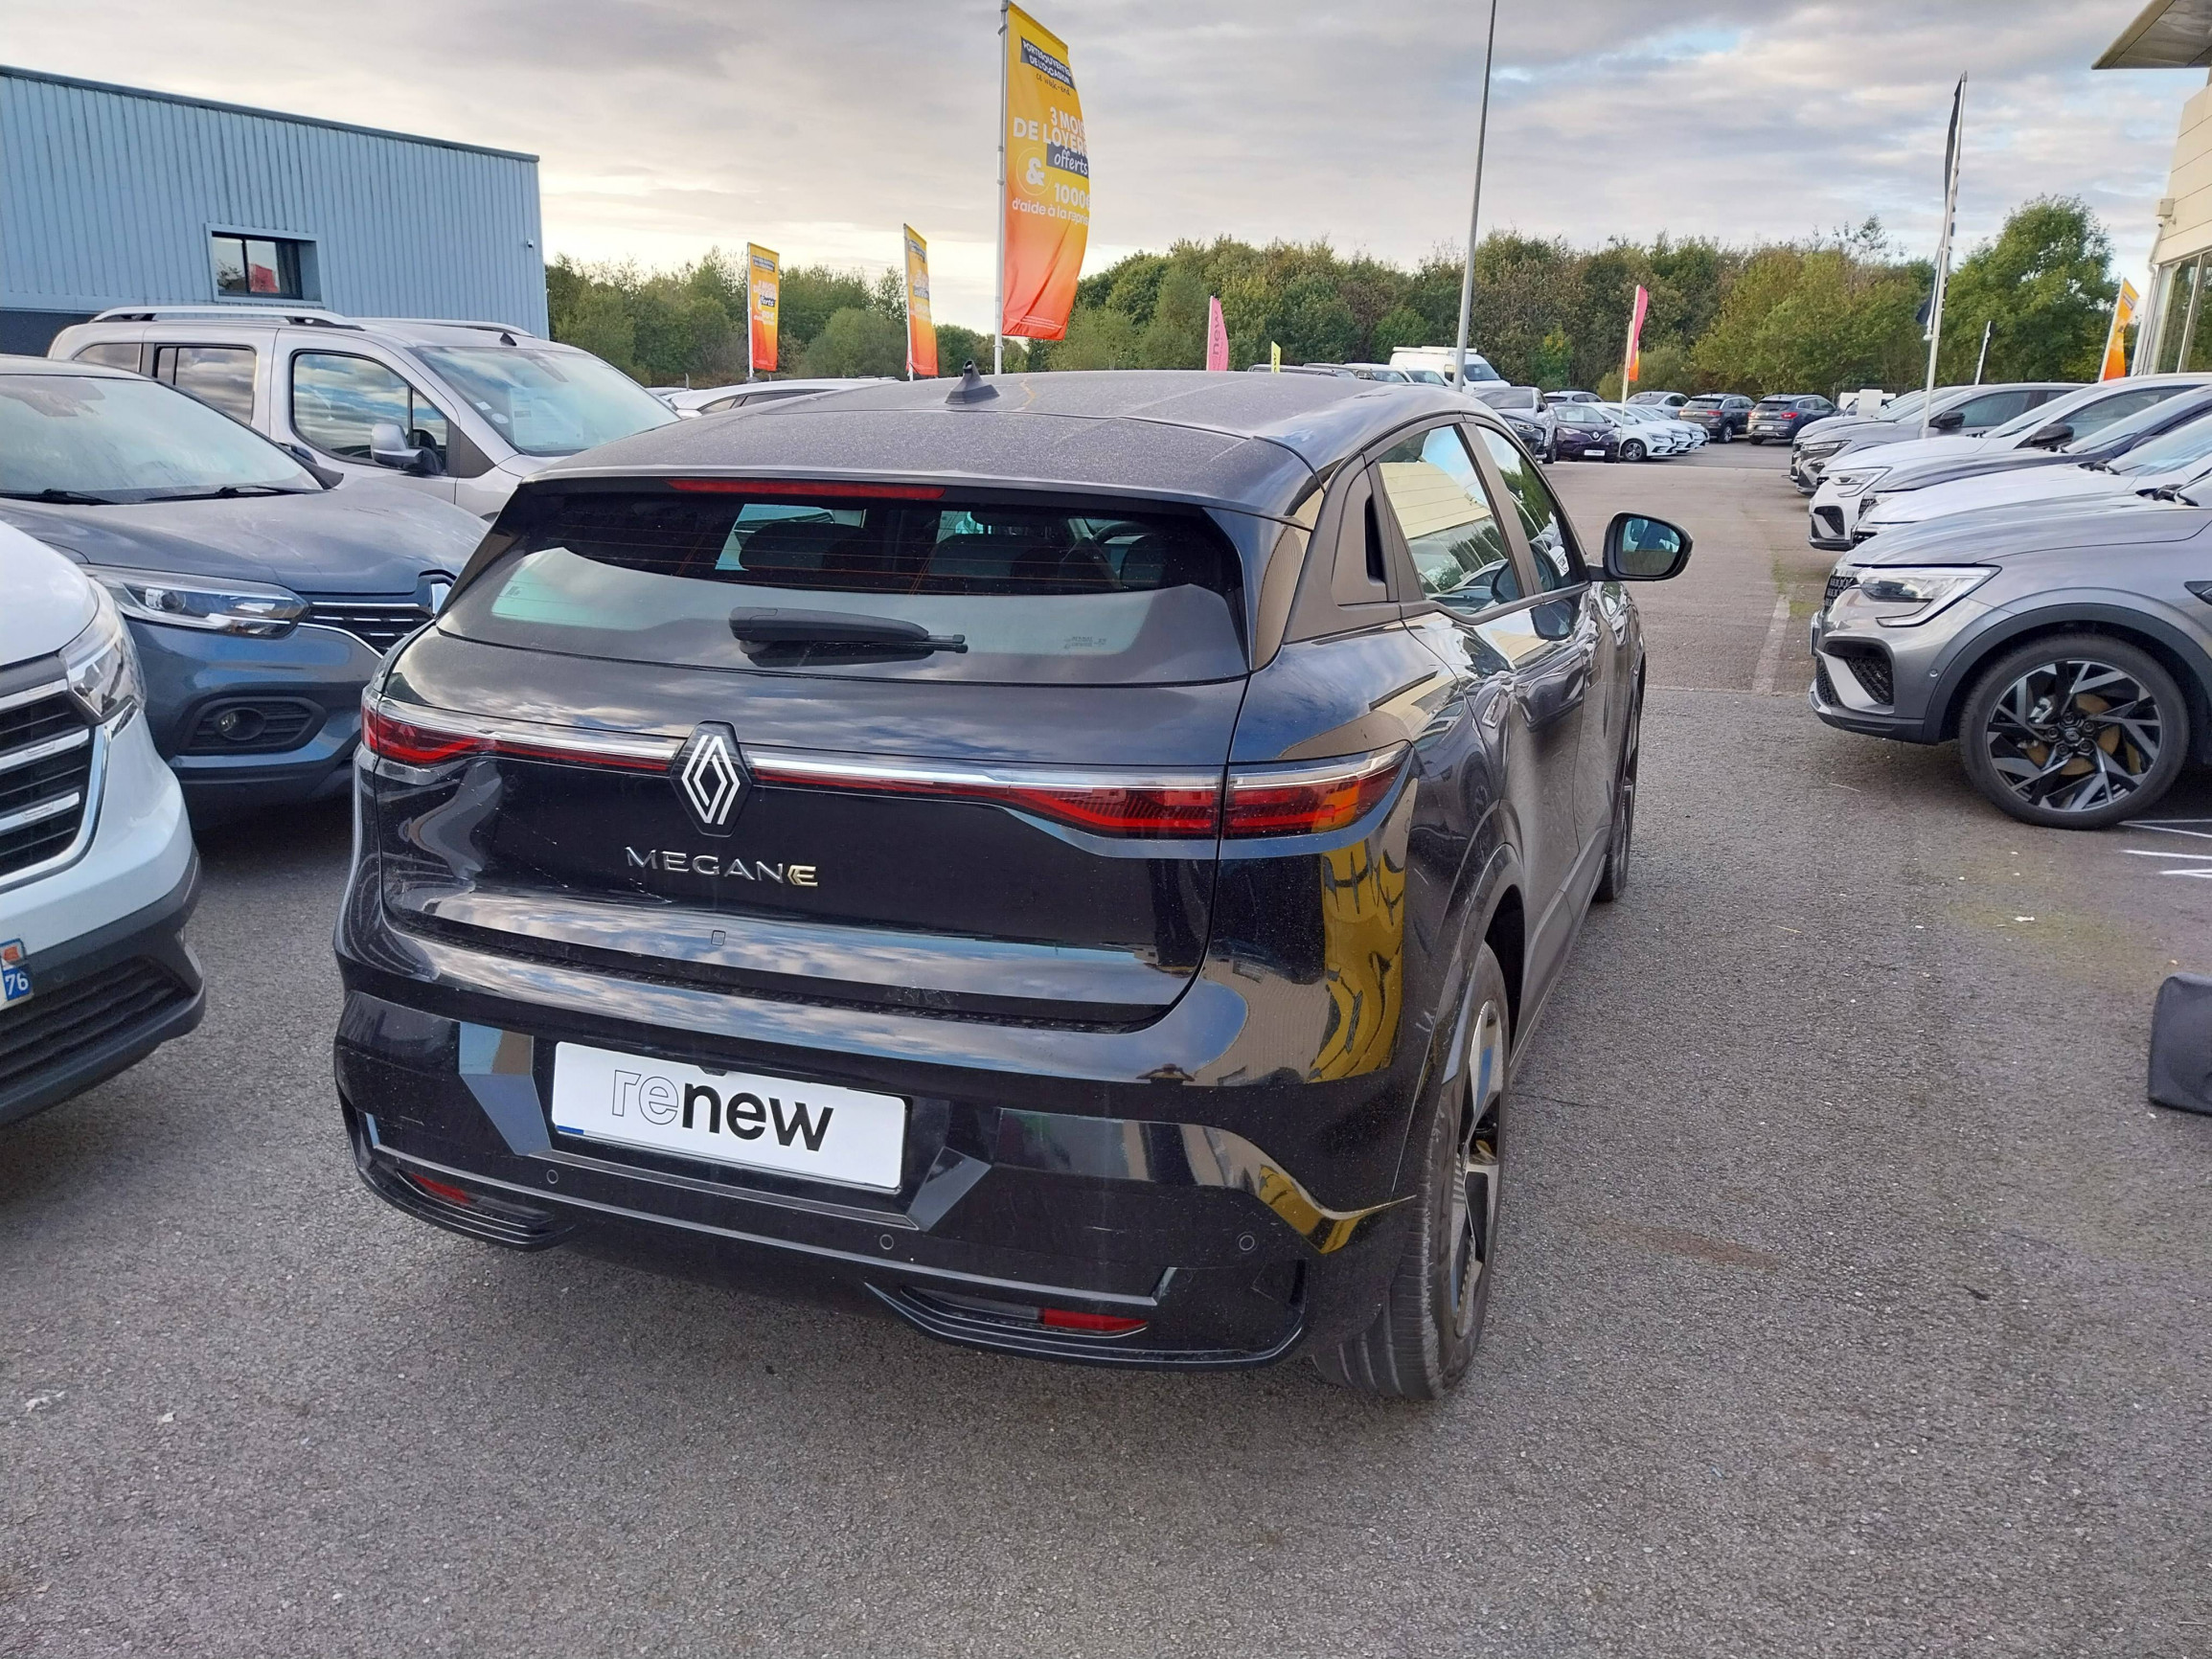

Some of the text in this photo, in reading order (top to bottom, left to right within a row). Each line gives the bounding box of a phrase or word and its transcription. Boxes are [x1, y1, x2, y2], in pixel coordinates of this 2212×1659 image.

[1029, 55, 1038, 66] DE
[1050, 106, 1086, 138] 3 MOIS
[1013, 117, 1088, 158] DE LOYERS
[1026, 157, 1045, 186] &
[1054, 149, 1087, 175] offerts
[1012, 197, 1046, 216] d'aide
[1048, 204, 1056, 217] à
[1057, 208, 1067, 219] la
[625, 846, 819, 887] MEGANE
[5, 973, 29, 996] 76
[611, 1069, 834, 1152] renew
